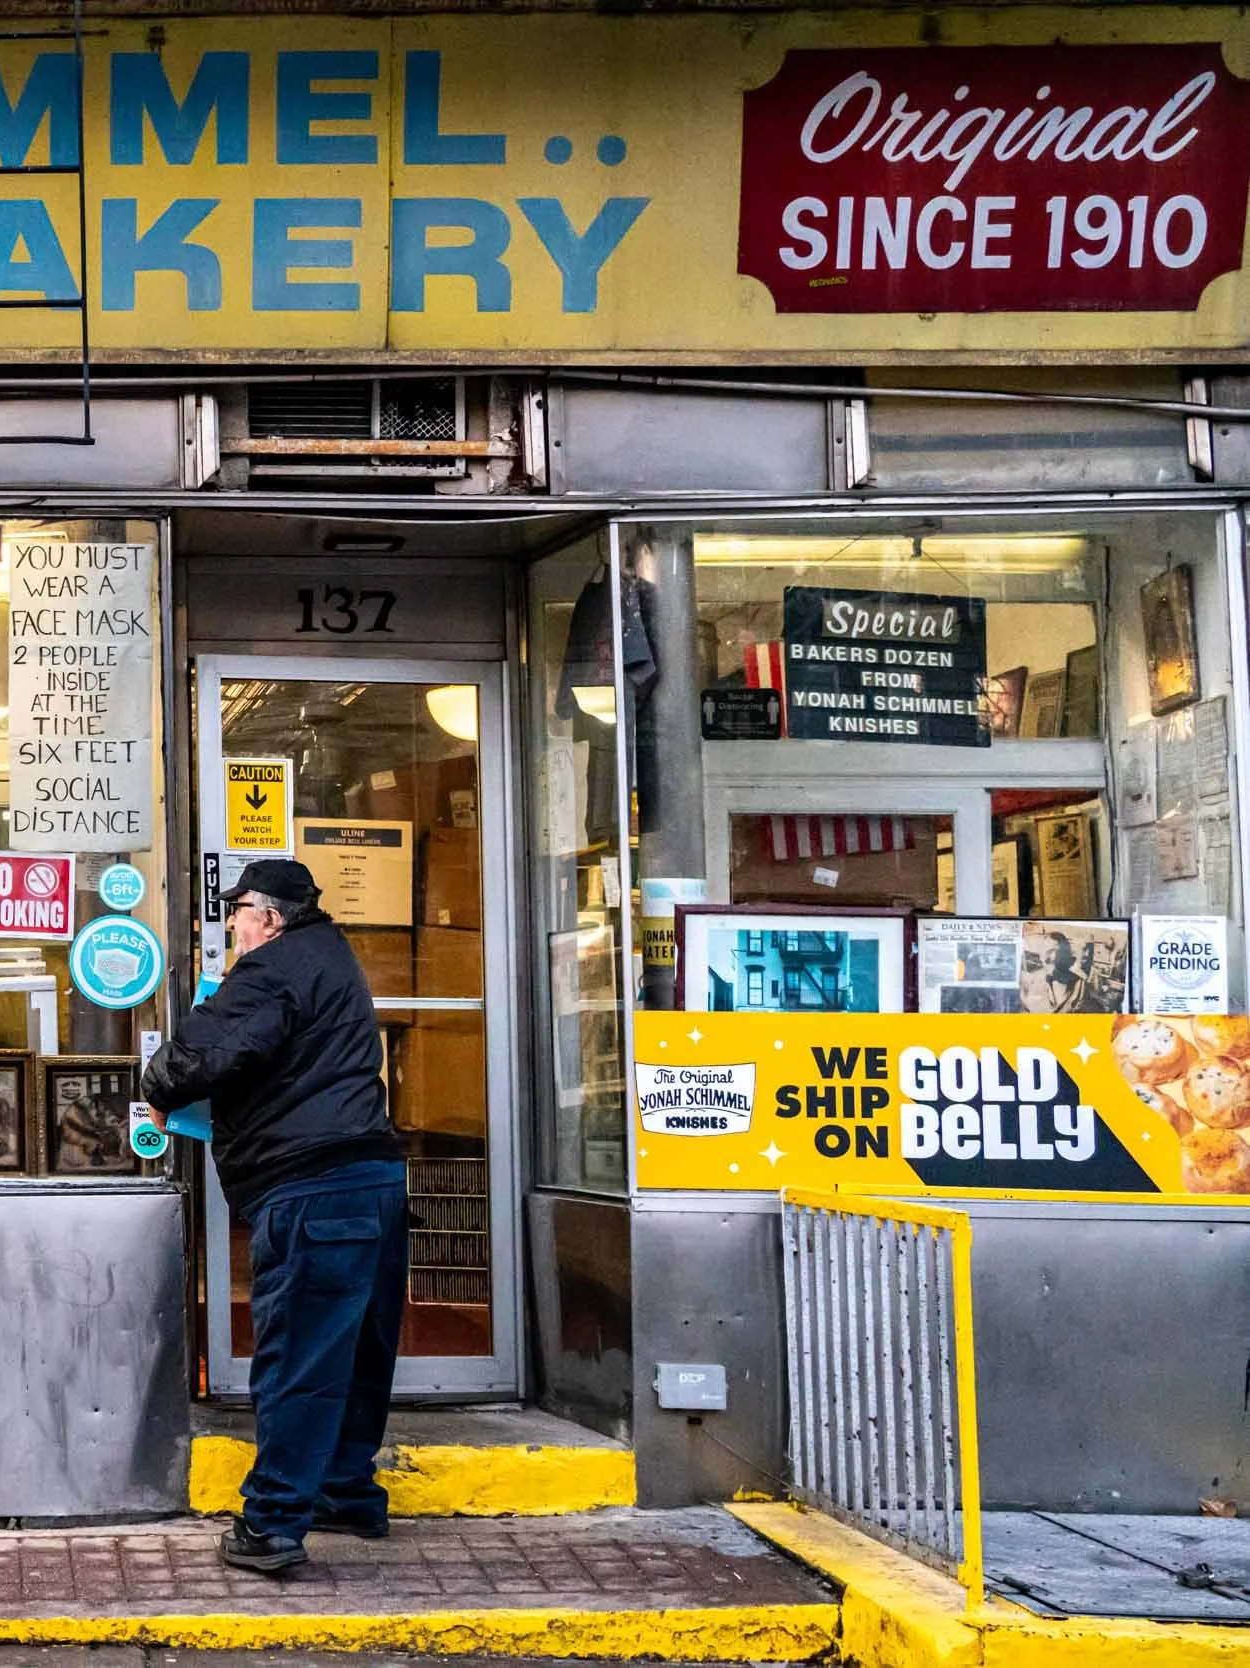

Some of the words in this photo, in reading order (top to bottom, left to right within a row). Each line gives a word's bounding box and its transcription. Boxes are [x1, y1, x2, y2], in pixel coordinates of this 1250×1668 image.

[800, 71, 1215, 192] Original
[779, 195, 1016, 271] SINCE
[1046, 194, 1208, 270] 1910
[15, 545, 64, 570] YOU
[75, 546, 145, 571] MUST
[23, 575, 88, 597] WEAR
[99, 575, 116, 596] A
[294, 583, 398, 634] 137
[826, 600, 955, 639] Special
[11, 609, 67, 637] FACE
[76, 609, 149, 637] MASK
[13, 645, 28, 665] 2
[38, 645, 118, 667] PEOPLE
[790, 643, 878, 664] BAKERS
[884, 648, 953, 667] DOZEN
[861, 671, 918, 689] FROM
[30, 694, 55, 712] AT
[64, 694, 108, 713] THE
[794, 691, 866, 710] YONAH
[874, 695, 979, 716] SCHIMMEL
[829, 716, 919, 735] KNISHES
[75, 740, 137, 764] FEET
[230, 766, 283, 781] CAUTION
[240, 815, 273, 823] PLEASE
[242, 826, 272, 834] WATCH
[234, 837, 257, 845] YOUR
[259, 837, 281, 845] STEP
[206, 858, 218, 917] PULL
[91, 932, 149, 952] PLEASE
[1157, 942, 1213, 956] GRADE
[1150, 957, 1220, 971] PENDING
[811, 1046, 889, 1080] WE
[898, 1045, 1059, 1103] GOLD
[654, 1068, 676, 1085] The
[680, 1069, 735, 1087] Original
[639, 1088, 682, 1111] YONAH
[685, 1087, 751, 1111] SCHIMMEL
[775, 1084, 890, 1118] SHIP
[665, 1116, 728, 1130] KNISHES
[814, 1124, 889, 1159] ON
